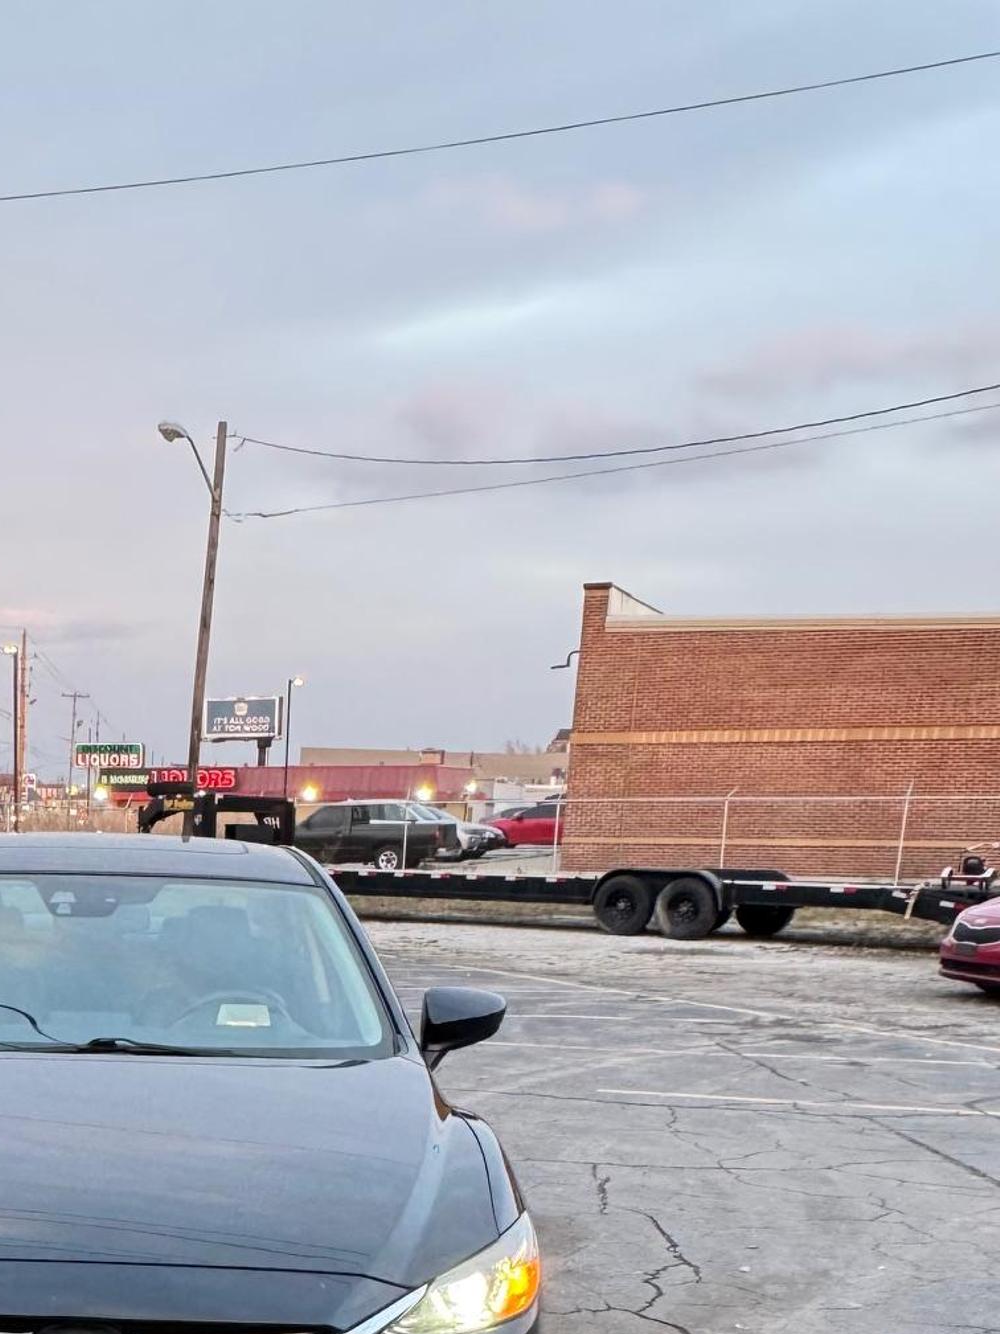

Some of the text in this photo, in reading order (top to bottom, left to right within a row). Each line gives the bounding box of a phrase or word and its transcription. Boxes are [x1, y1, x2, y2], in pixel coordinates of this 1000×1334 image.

[229, 716, 244, 724] ALL
[246, 716, 271, 724] GOOD
[77, 753, 138, 766] LIQUORS
